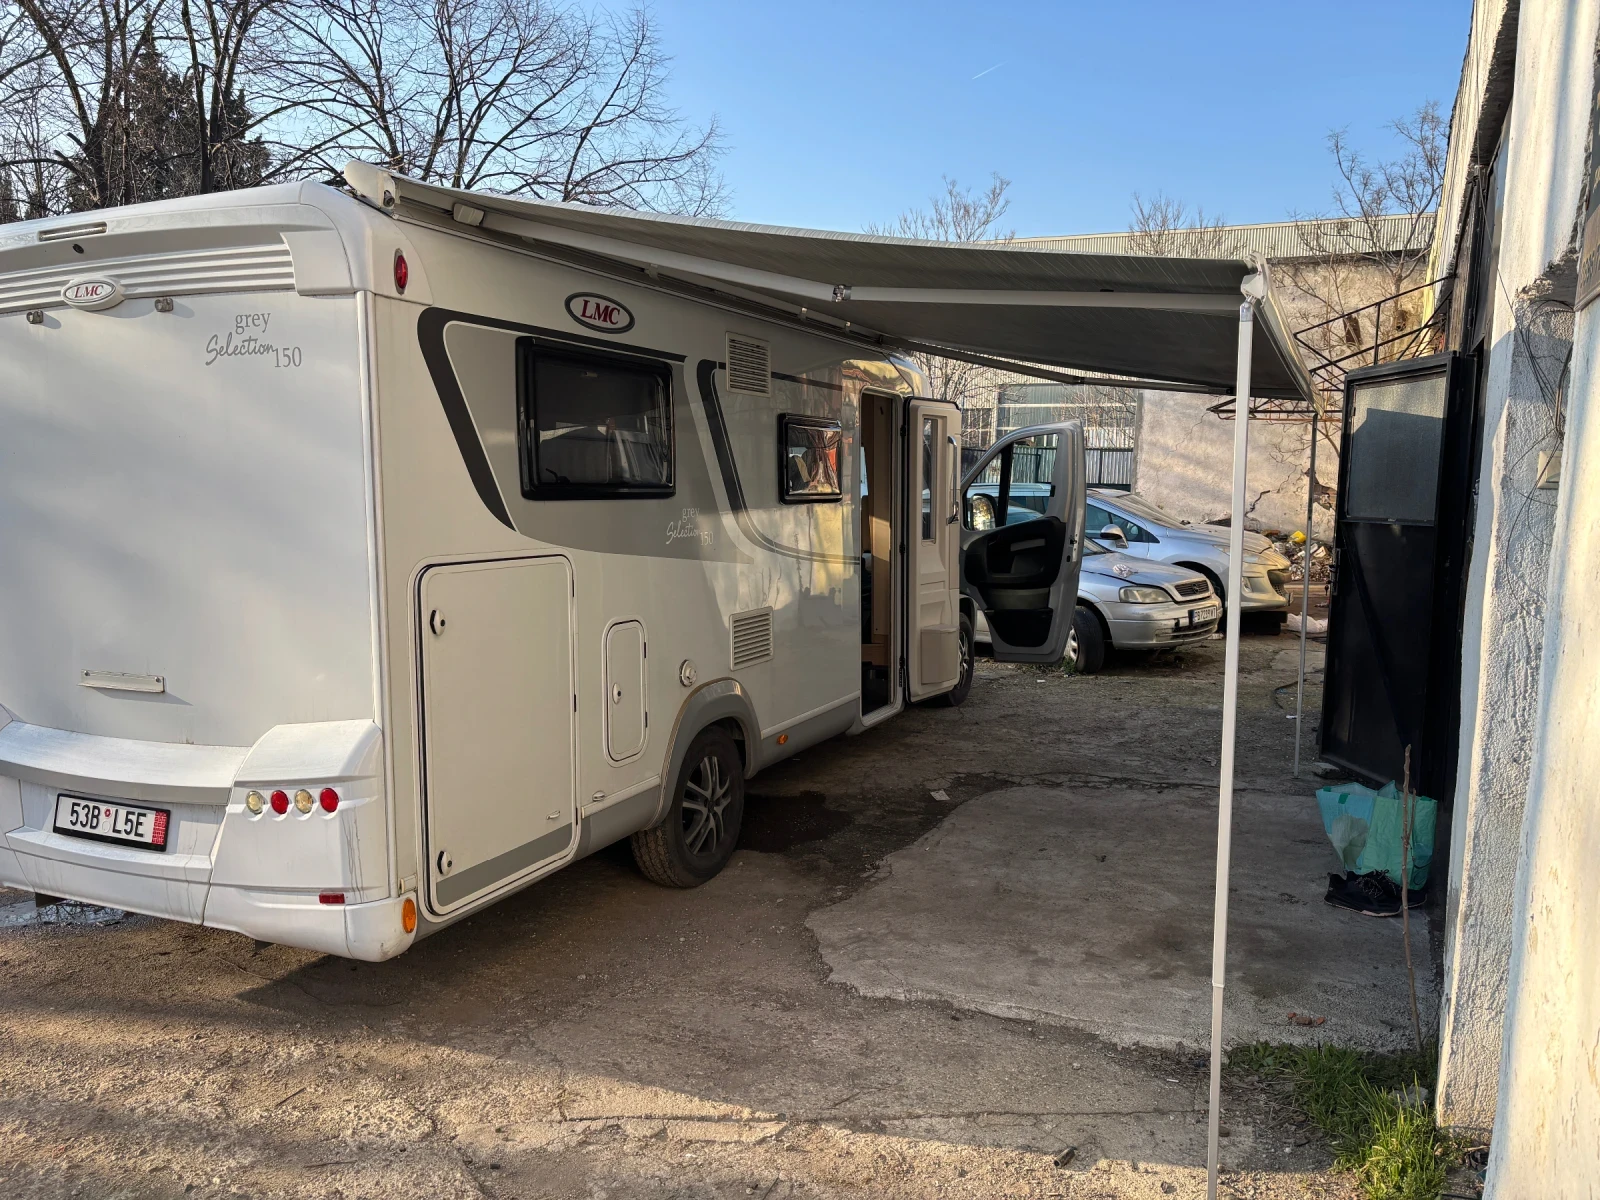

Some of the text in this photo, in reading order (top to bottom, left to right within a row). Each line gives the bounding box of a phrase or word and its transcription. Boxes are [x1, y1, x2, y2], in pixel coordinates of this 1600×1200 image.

[74, 285, 104, 298] LMC
[235, 312, 271, 335] grey
[580, 299, 620, 325] LMC
[205, 332, 302, 367] Selection 150
[682, 508, 700, 522] grey
[700, 531, 714, 546] 150
[69, 802, 101, 830] 53B
[112, 808, 147, 838] L5E
